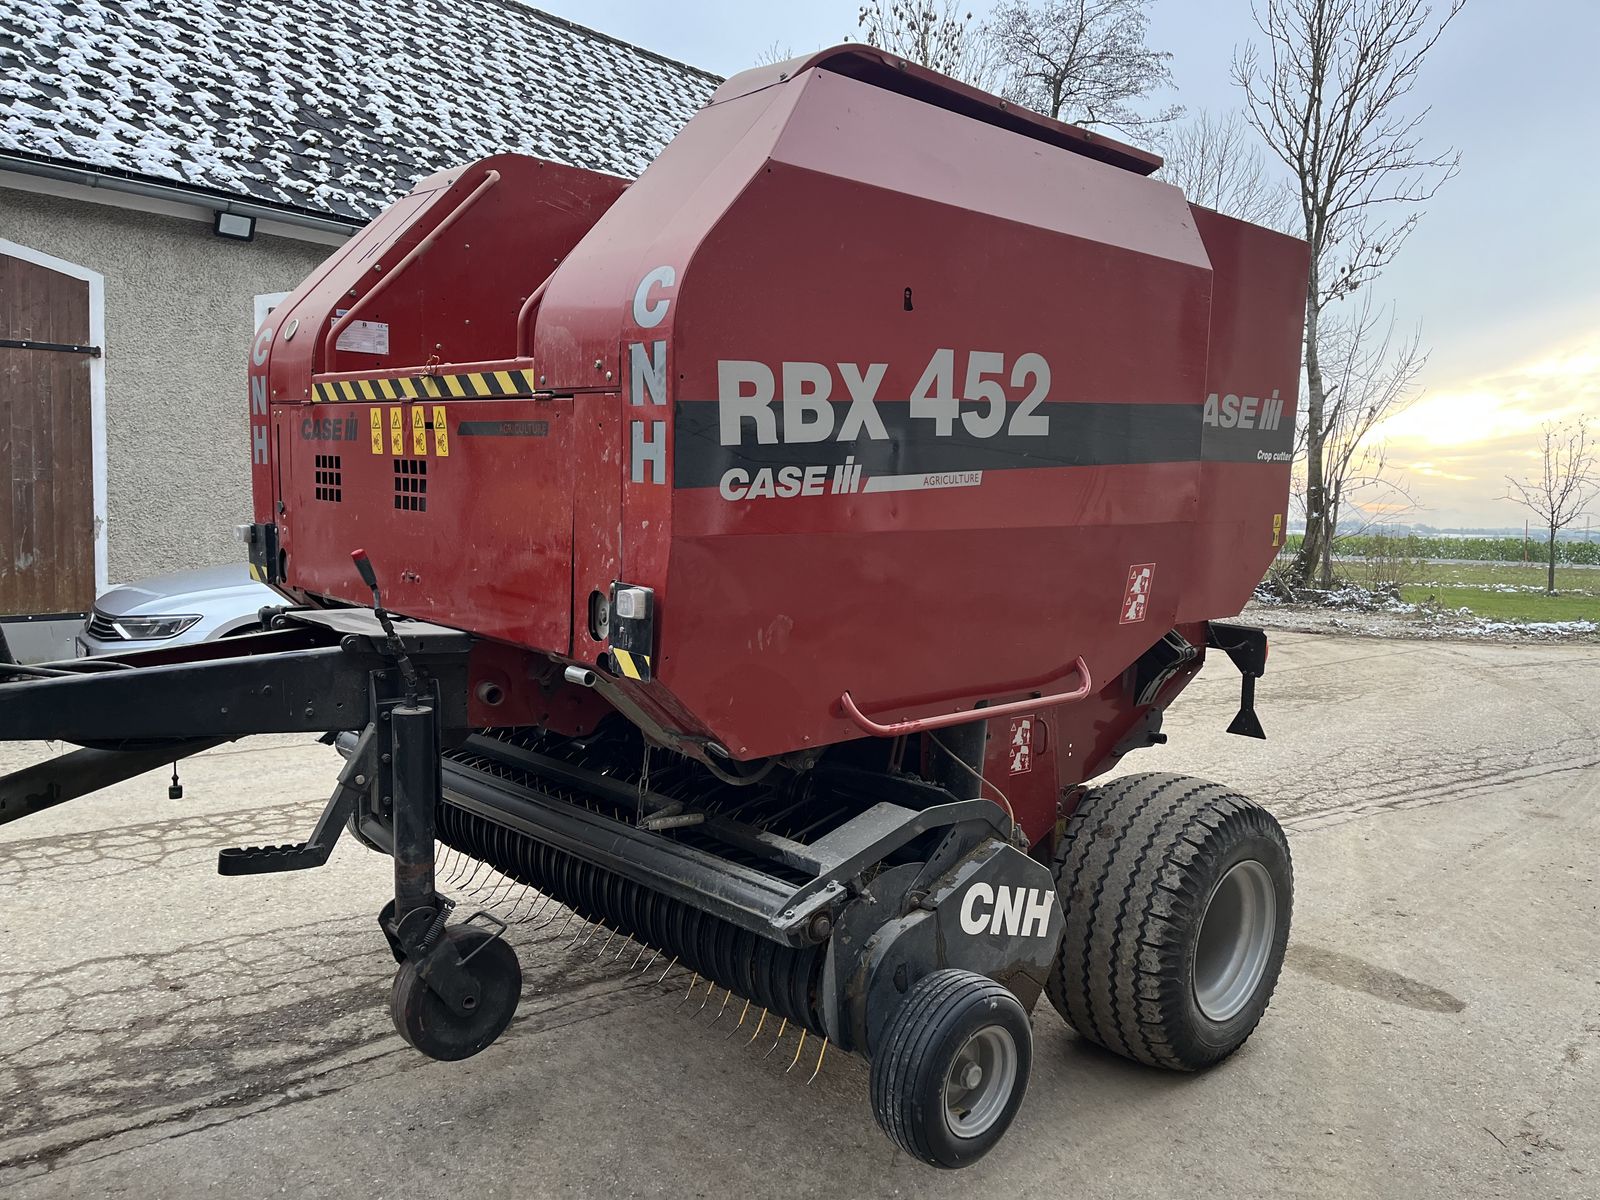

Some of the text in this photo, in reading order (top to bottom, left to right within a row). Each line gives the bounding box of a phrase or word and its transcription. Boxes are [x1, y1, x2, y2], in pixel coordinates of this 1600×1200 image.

[253, 329, 271, 465] CNH
[631, 265, 676, 484] CNH
[718, 348, 1051, 446] RBX 452
[301, 417, 343, 441] CASE
[1203, 394, 1259, 429] ASE
[1257, 449, 1273, 463] Crop
[719, 466, 828, 501] CASE
[924, 471, 981, 488] AGRICULTURE
[960, 882, 1055, 938] CNH
